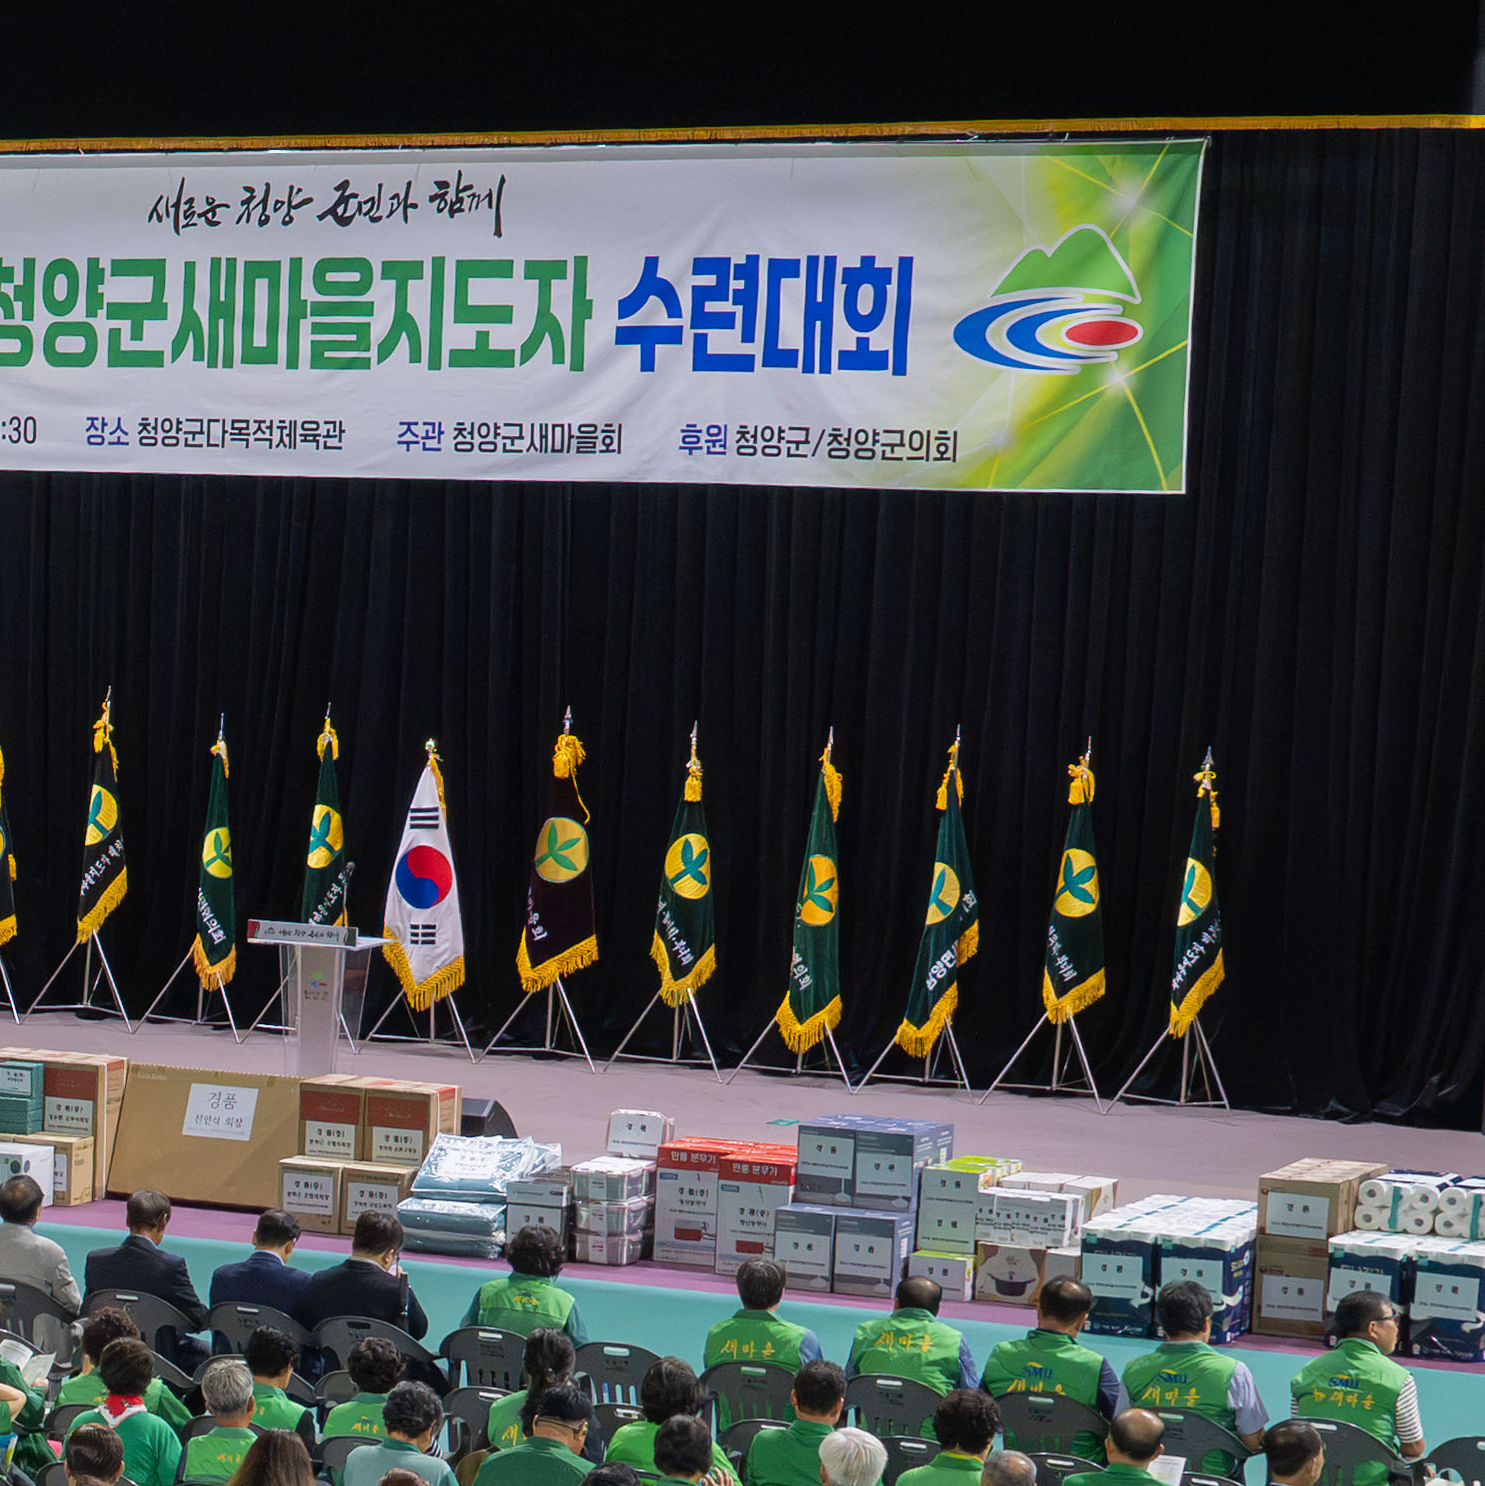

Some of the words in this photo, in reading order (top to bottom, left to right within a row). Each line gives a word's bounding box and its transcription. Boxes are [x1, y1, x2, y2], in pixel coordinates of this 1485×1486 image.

[147, 177, 229, 236] 새로운
[235, 182, 313, 228] 청양
[317, 179, 419, 226] 군민과
[429, 170, 507, 239] 함께
[614, 254, 915, 377] 수련대회
[84, 416, 131, 448] 장소
[136, 417, 346, 452] 청양군다목적체육관
[396, 421, 444, 453] 주관
[451, 421, 624, 456] 청양군새마을회
[677, 423, 729, 457] 후원
[733, 426, 959, 465] 청양군/청양군의회
[719, 1339, 776, 1360] 새마을
[1140, 1387, 1200, 1408] 새마을
[1329, 1390, 1375, 1411] 새마을
